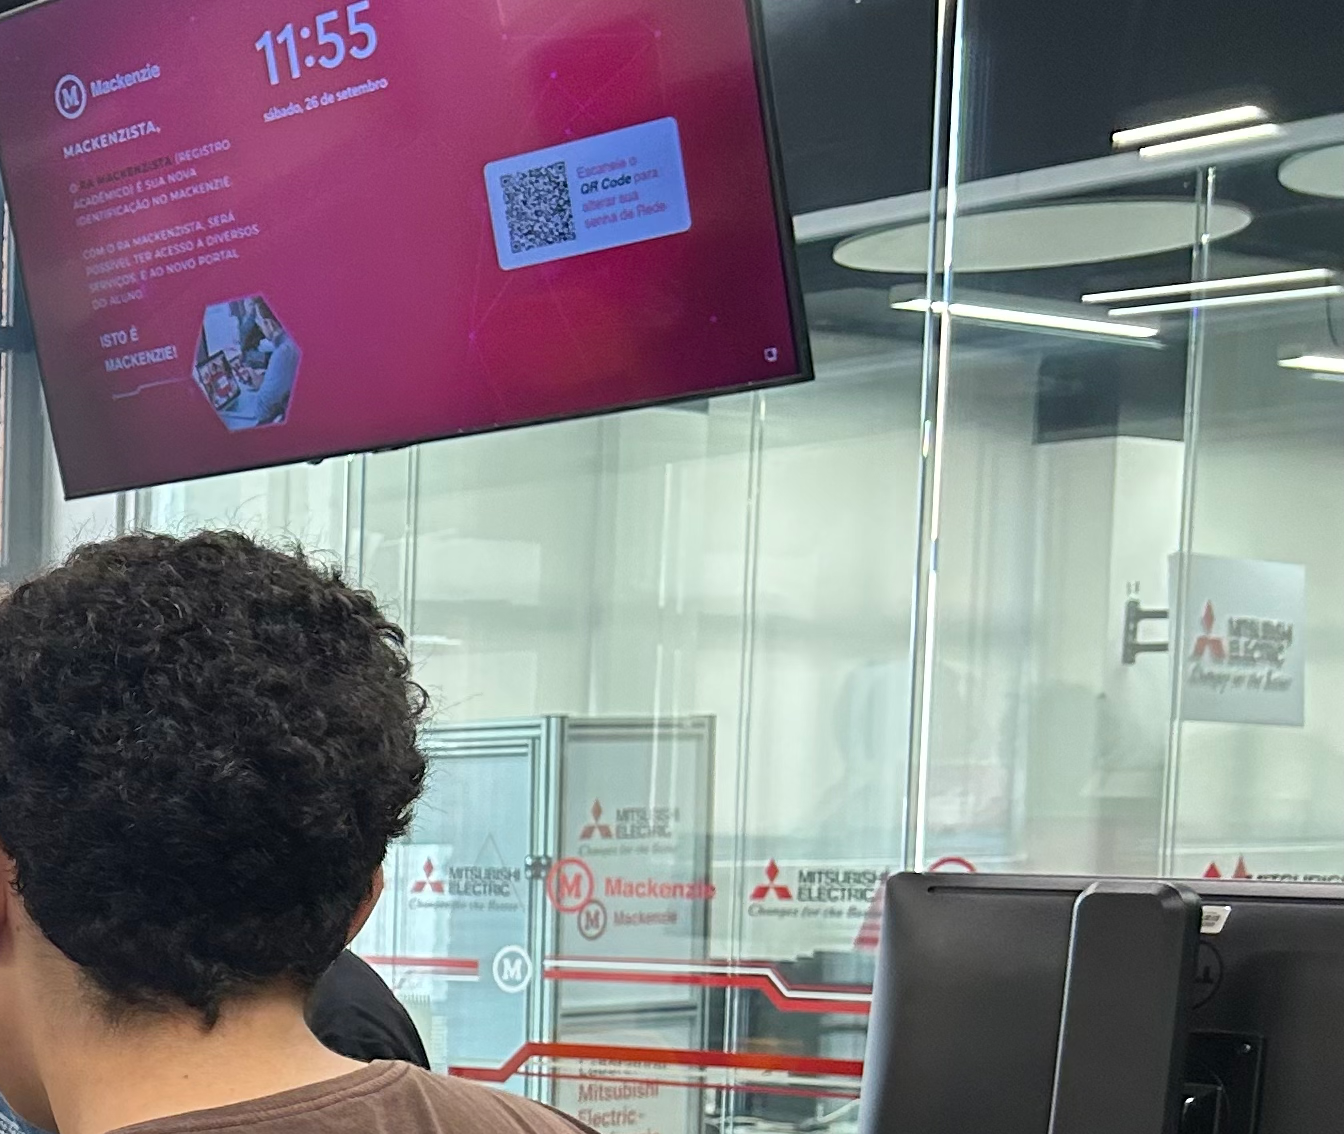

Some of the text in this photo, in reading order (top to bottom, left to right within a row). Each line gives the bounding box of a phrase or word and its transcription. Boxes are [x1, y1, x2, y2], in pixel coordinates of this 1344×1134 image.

[254, 0, 378, 86] 11:55
[90, 63, 161, 97] Mackenzie
[304, 95, 319, 110] 26
[320, 92, 335, 106] de
[336, 77, 388, 101] setembro
[167, 168, 197, 185] NOVA
[580, 180, 599, 195] QR
[601, 173, 632, 190] Code
[153, 194, 168, 206] NO
[133, 251, 152, 265] TER
[154, 241, 194, 260] ACESSO
[196, 238, 204, 249] A
[206, 223, 260, 247] DIVERSOS
[166, 257, 196, 275] NOVO
[198, 249, 240, 267] PORTAL
[100, 330, 128, 349] ISTO
[104, 345, 178, 373] MACKENZIE!
[448, 881, 510, 897] ELECTRIC
[605, 877, 716, 899] Mackenzie
[798, 887, 875, 902] ELECTRIC
